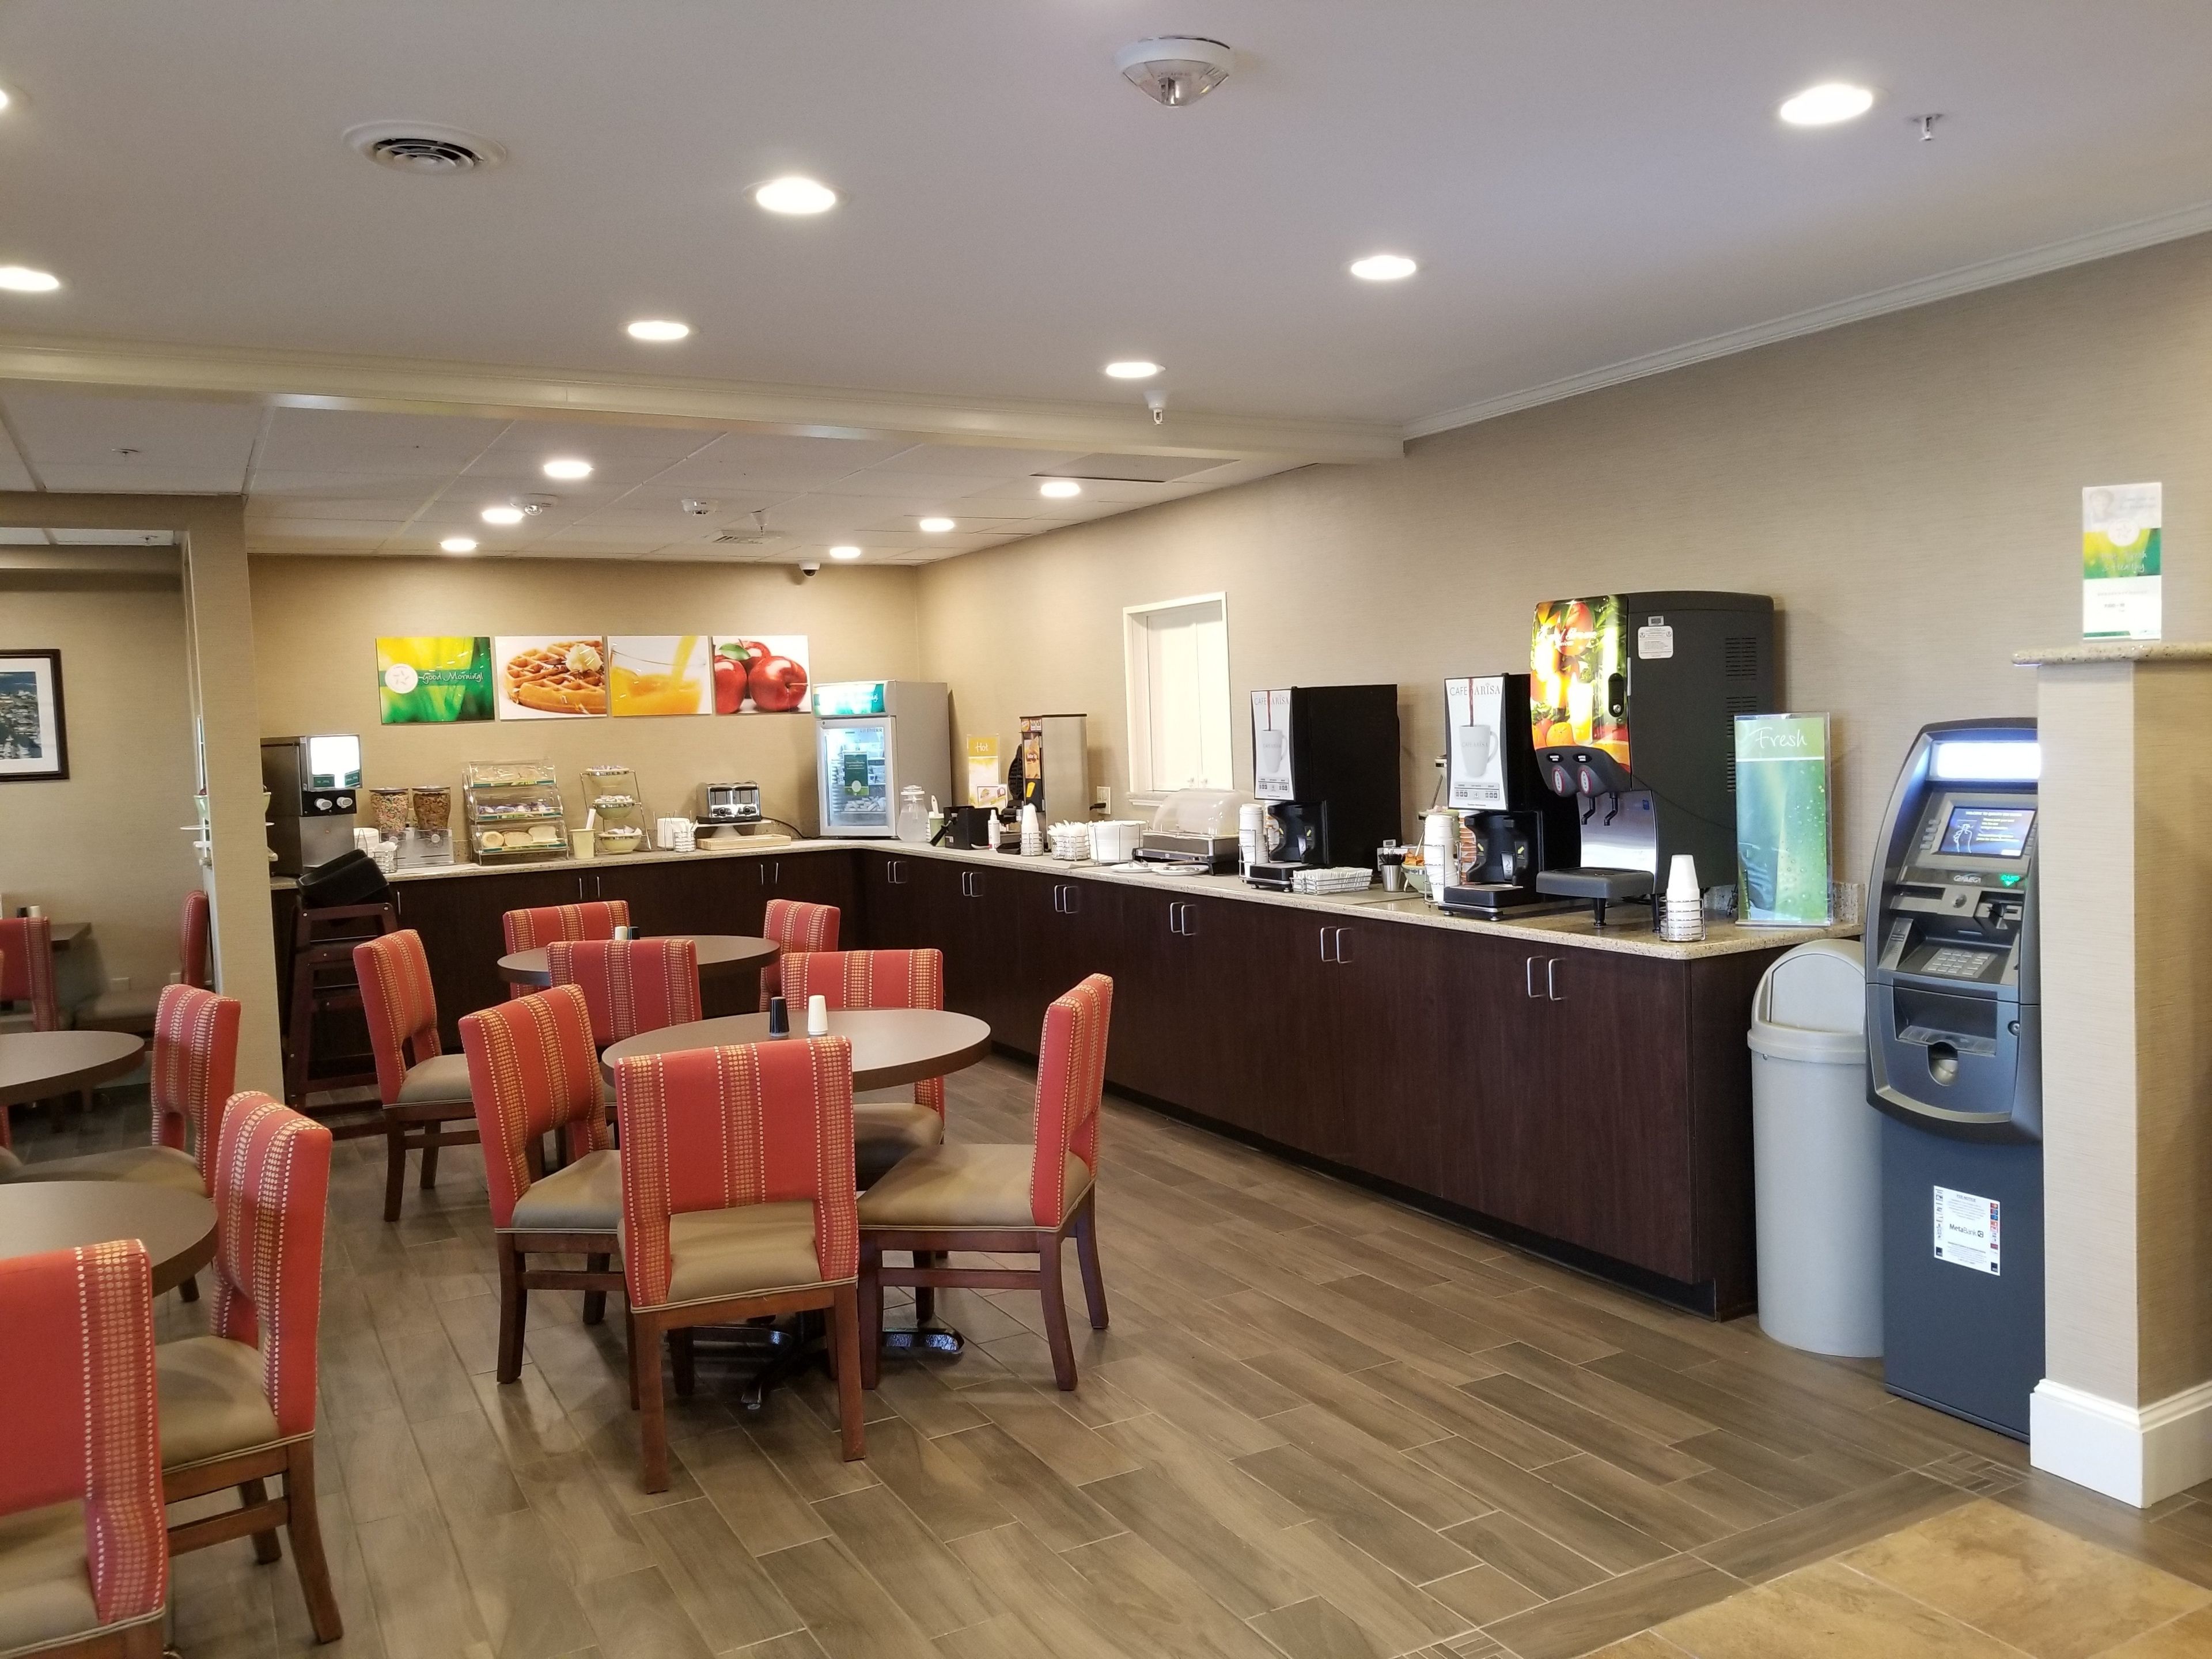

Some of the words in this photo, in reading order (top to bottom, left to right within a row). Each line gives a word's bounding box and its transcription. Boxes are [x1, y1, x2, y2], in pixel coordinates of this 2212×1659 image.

[444, 671, 483, 683] Morning!
[1449, 686, 1468, 696] CAFE
[1749, 726, 1808, 749] Fresh
[975, 741, 989, 753] Hot
[1949, 1224, 1977, 1236] MetaBank
